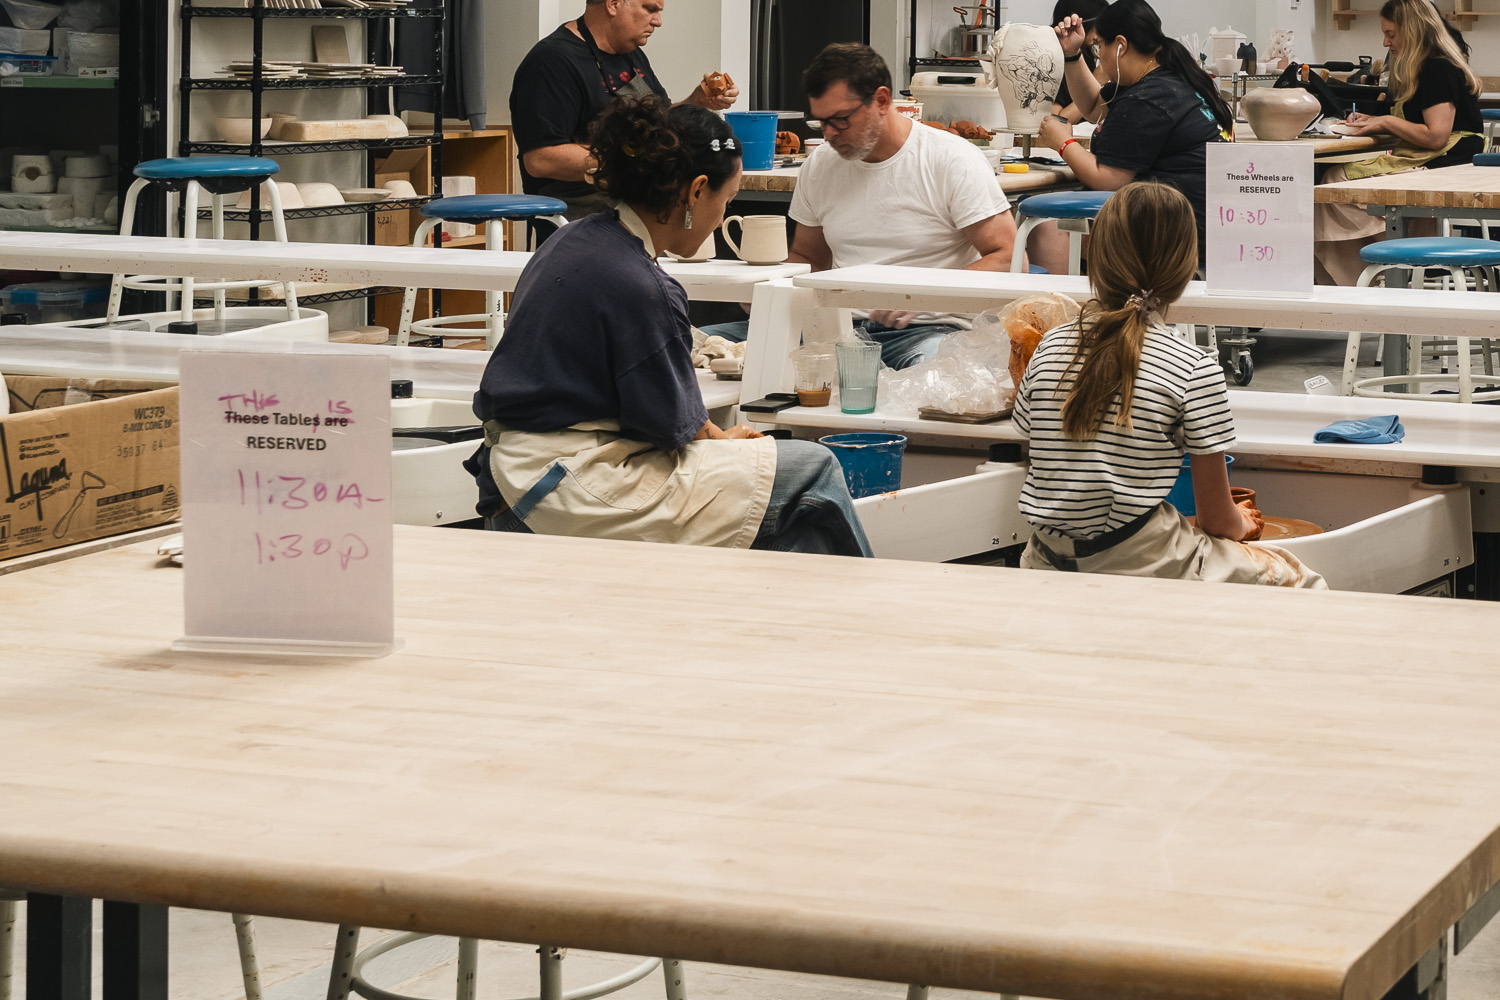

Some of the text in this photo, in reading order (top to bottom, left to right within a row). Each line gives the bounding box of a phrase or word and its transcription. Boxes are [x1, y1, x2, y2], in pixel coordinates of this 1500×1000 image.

[1246, 162, 1255, 174] 3
[1226, 173, 1249, 181] These
[1251, 174, 1280, 182] Wheels
[1239, 186, 1281, 194] RESERVED
[1239, 244, 1274, 261] 1:30
[218, 389, 353, 415] THIS IS
[134, 406, 166, 420] WC379
[224, 411, 269, 425] These
[324, 416, 349, 427] are
[122, 422, 144, 433] B-MIX
[144, 420, 163, 431] CONE
[246, 435, 327, 451] RESERVED
[991, 537, 1000, 545] 25
